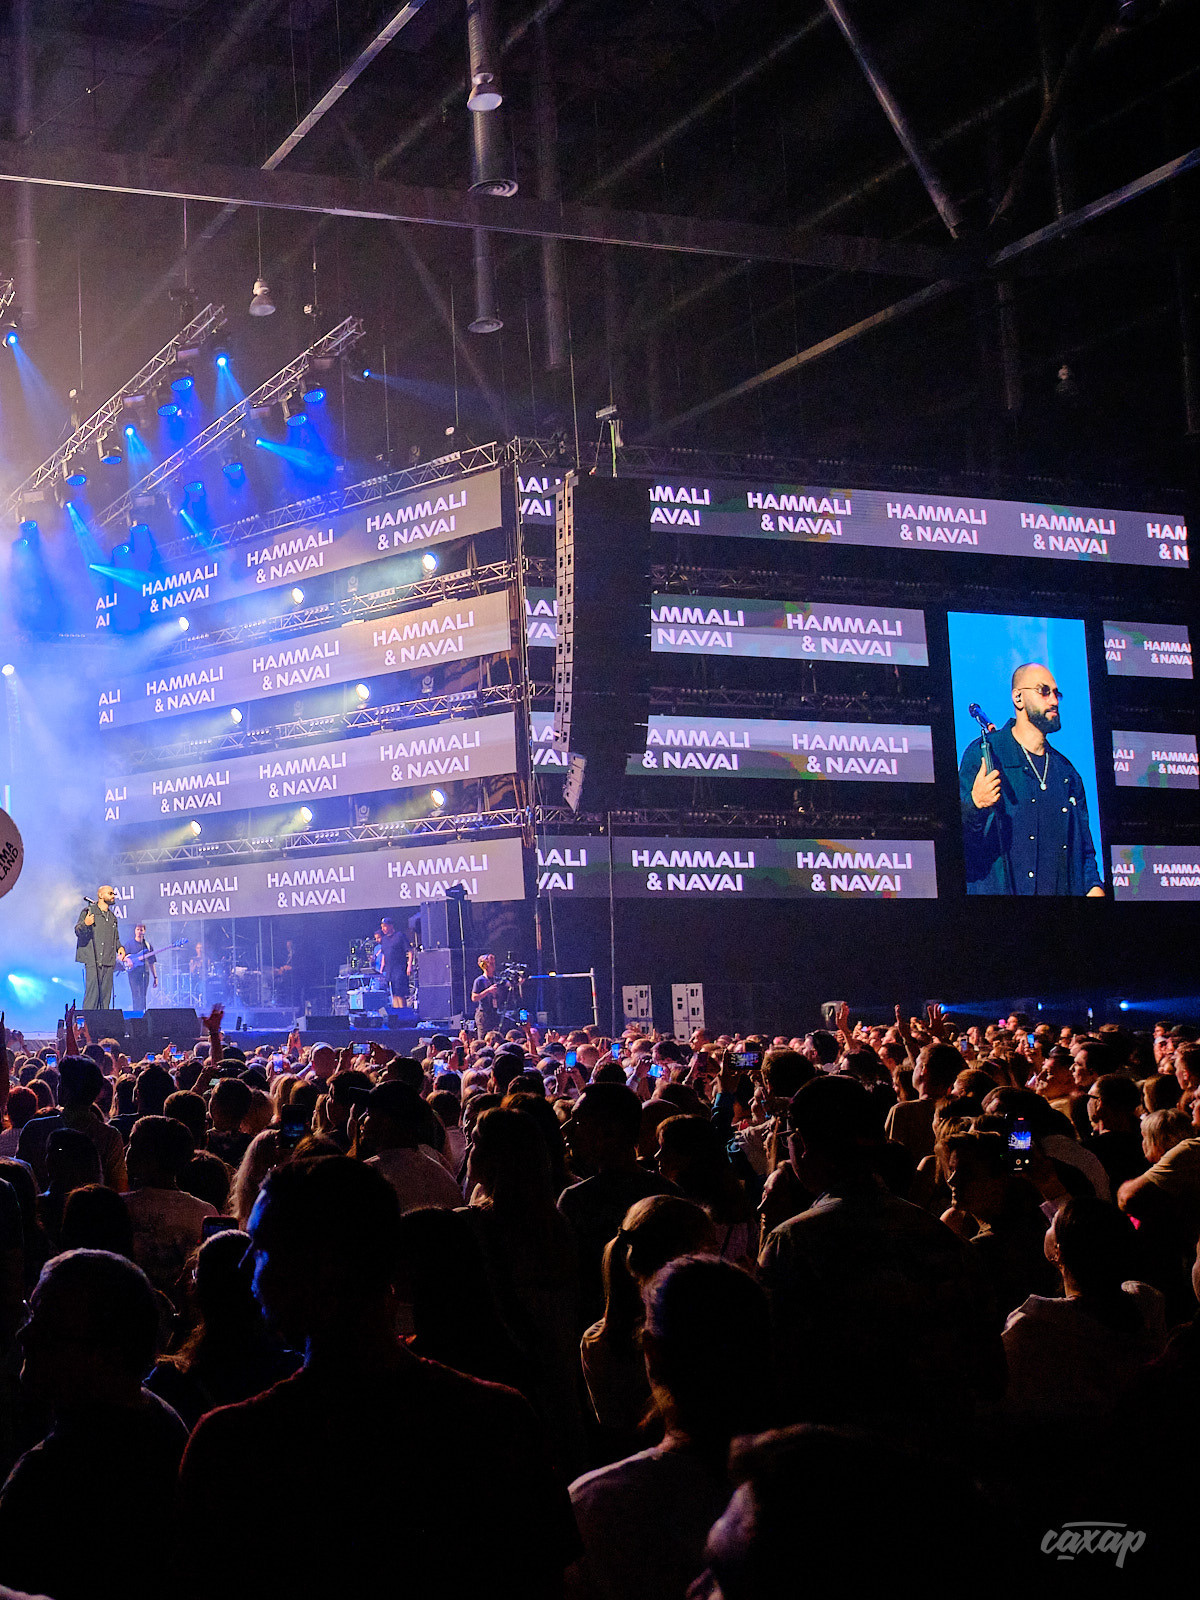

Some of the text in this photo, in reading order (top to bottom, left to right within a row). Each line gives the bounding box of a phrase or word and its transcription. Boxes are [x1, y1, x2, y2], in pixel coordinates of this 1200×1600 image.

[649, 486, 710, 505] MALI
[747, 492, 851, 515] HAMMALI
[366, 490, 467, 533] HAMMALI
[650, 507, 700, 526] AVAI
[886, 502, 987, 525] HAMMALI
[377, 515, 456, 551] & NAVAI
[760, 514, 842, 535] & NAVAI
[900, 524, 978, 545] & NAVAI
[1020, 512, 1116, 535] HAMMALI
[247, 528, 334, 567] HAMMALI
[1033, 534, 1108, 554] & NAVAI
[256, 552, 324, 584] & NAVAI
[142, 563, 218, 597] HAMMALI
[150, 585, 210, 613] & NAVAI
[651, 606, 744, 627] MMALI
[786, 613, 902, 636] HAMMALI
[373, 610, 474, 646] HAMMALI
[657, 628, 733, 648] NAVAI
[252, 640, 340, 673] HAMMALI
[384, 636, 464, 666] & NAVAI
[801, 635, 892, 657] & NAVAI
[1151, 653, 1159, 663] &
[146, 667, 223, 696] HAMMALI
[262, 664, 330, 690] & NAVAI
[154, 688, 215, 712] & NAVAI
[379, 730, 481, 761] HAMMALI
[646, 729, 750, 748] AMMALI
[792, 733, 908, 753] HAMMALI
[259, 752, 346, 780] HAMMALI
[391, 755, 470, 781] & NAVAI
[642, 750, 738, 770] & NAVAI
[806, 755, 898, 775] & NAVAI
[1158, 763, 1166, 774] &
[152, 771, 230, 795] HAMMALI
[268, 774, 337, 798] & NAVAI
[160, 791, 221, 813] & NAVAI
[387, 854, 488, 878] HAMMALI
[631, 850, 755, 868] HAMMALI
[796, 851, 912, 870] HAMMALI
[159, 876, 238, 898] HAMMALI
[267, 866, 354, 888] HAMMALI
[646, 872, 743, 891] & NAVAI
[811, 873, 901, 891] & NAVAI
[1160, 876, 1200, 887] & NAVA
[277, 888, 346, 907] & NAVAI
[400, 882, 411, 899] &
[169, 896, 230, 915] & NAVAI
